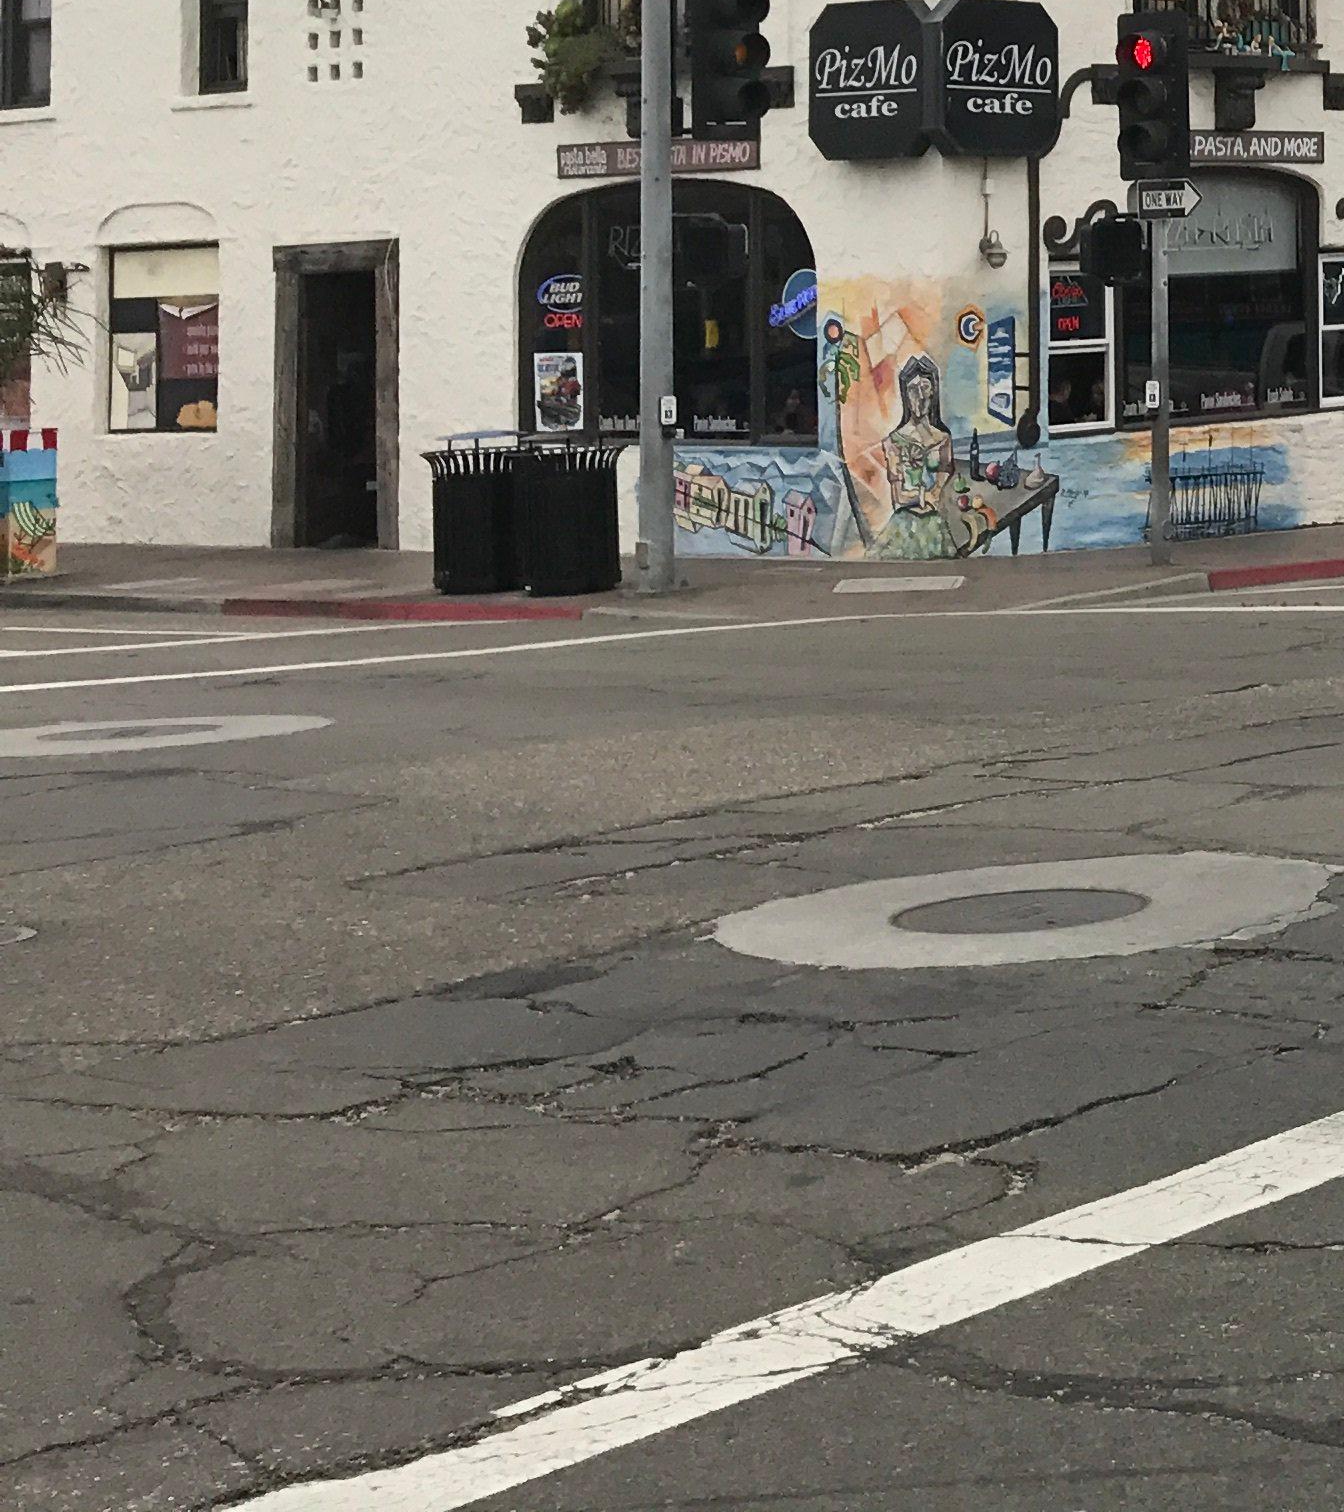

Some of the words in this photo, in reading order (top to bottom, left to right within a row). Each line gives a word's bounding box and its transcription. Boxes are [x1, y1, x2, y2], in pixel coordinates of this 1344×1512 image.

[816, 44, 917, 89] PizMo
[946, 39, 1052, 85] PizMo
[834, 95, 899, 119] cafe
[966, 93, 1033, 115] cafe
[617, 148, 641, 170] BES
[692, 145, 705, 164] IN
[709, 142, 750, 163] PISMO
[1194, 136, 1248, 158] PASTA,
[1250, 137, 1281, 156] AND
[1283, 137, 1318, 156] MORE
[1145, 192, 1162, 208] ONE
[1165, 190, 1184, 206] WAY
[543, 292, 582, 304] LIGHT
[549, 282, 580, 292] BUD
[544, 313, 584, 328] OPEN
